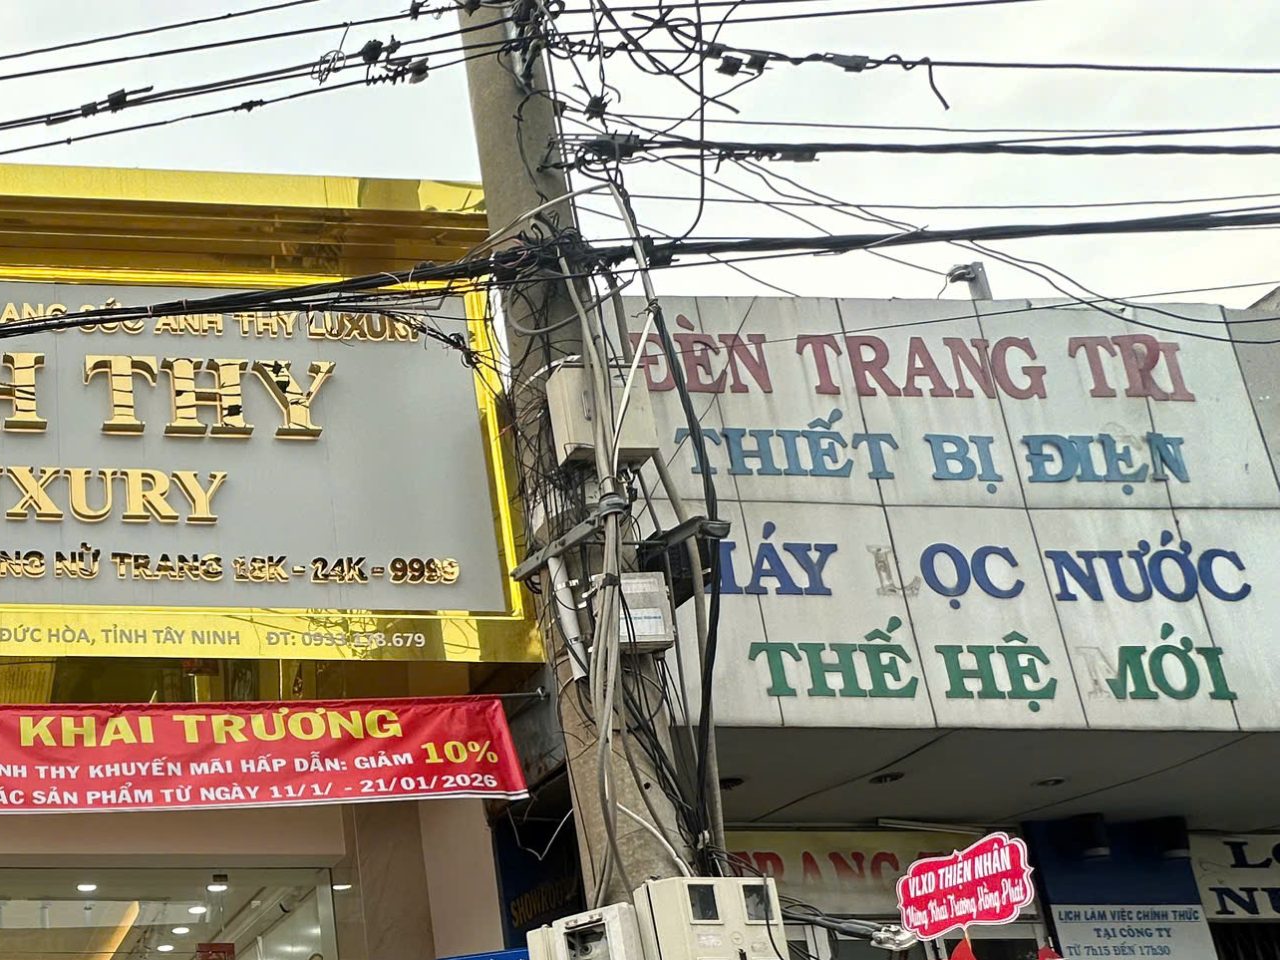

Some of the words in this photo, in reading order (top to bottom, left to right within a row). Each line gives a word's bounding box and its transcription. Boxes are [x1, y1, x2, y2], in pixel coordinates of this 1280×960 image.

[153, 310, 224, 337] ANH
[233, 310, 297, 338] THY
[629, 315, 773, 395] ĐÈN
[797, 334, 1047, 400] TRANG
[84, 355, 336, 440] THY
[675, 408, 899, 481] THIẾT
[923, 432, 1003, 494] BỊ
[111, 551, 222, 582] TRANG
[233, 555, 289, 584] 18K
[310, 556, 369, 585] 24K
[388, 557, 460, 584] 9999
[1044, 530, 1252, 602] NƯỚC
[47, 623, 96, 648] HÒA,
[101, 621, 149, 646] TỈNH
[153, 623, 188, 646] TÂY
[191, 628, 241, 647] NINH
[266, 631, 296, 647] ĐT:
[749, 616, 919, 699] THẾ
[934, 630, 1058, 713] HỆ
[20, 714, 154, 748] KHAI
[173, 706, 404, 744] TRƯƠNG
[35, 762, 80, 780] THY
[88, 757, 184, 779] KHUYẾN
[189, 757, 234, 776] MÃI
[240, 753, 285, 775] HẤP
[294, 752, 348, 773] DẪN:
[353, 749, 414, 771] GIẢM
[423, 740, 498, 766] 10%
[32, 783, 79, 806] SẢN
[86, 781, 156, 805] PHẨM
[159, 783, 195, 804] TỪ
[200, 781, 260, 803] NGÀY
[908, 872, 936, 899] VLXD
[938, 855, 972, 891] THIỆN
[974, 843, 1012, 880] NHÂN
[1157, 927, 1173, 939] TY
